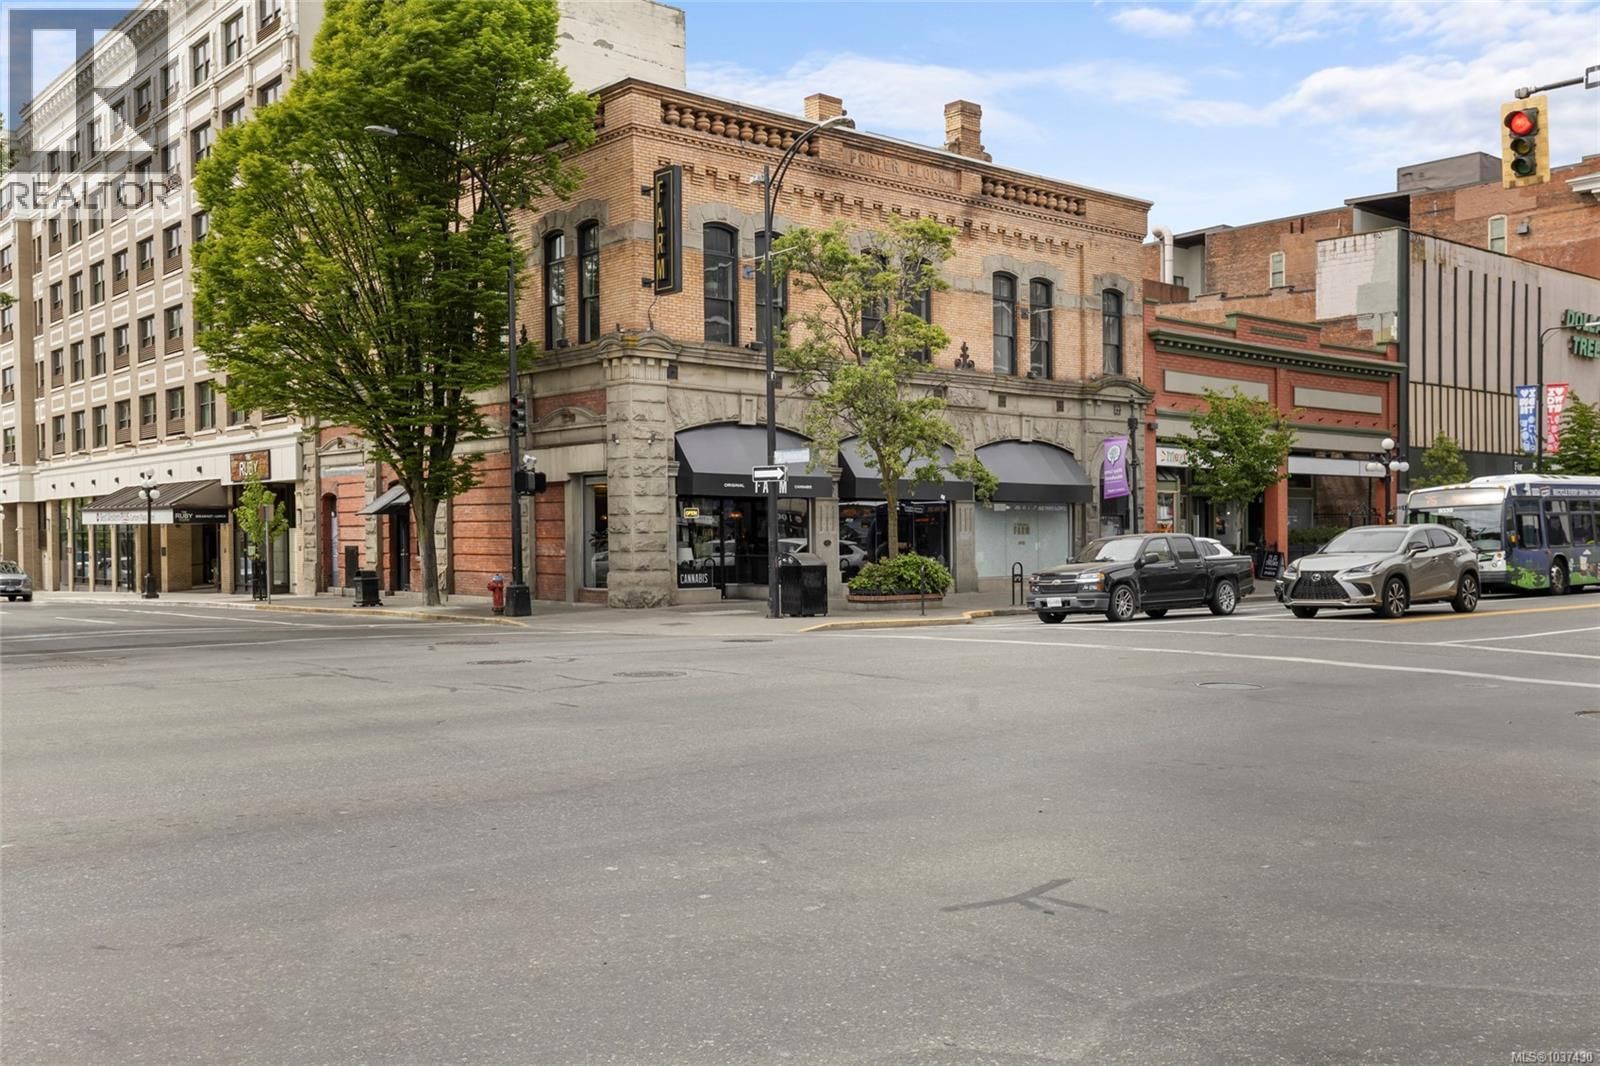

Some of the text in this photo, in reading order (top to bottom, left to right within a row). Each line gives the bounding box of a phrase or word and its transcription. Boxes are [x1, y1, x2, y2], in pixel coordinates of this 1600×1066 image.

[850, 150, 946, 184] PORTER BLOCK
[656, 180, 665, 280] FARM
[1573, 336, 1600, 359] TREE
[239, 460, 259, 477] RUBY
[755, 481, 788, 494] FAM
[680, 573, 709, 584] CANNABIS
